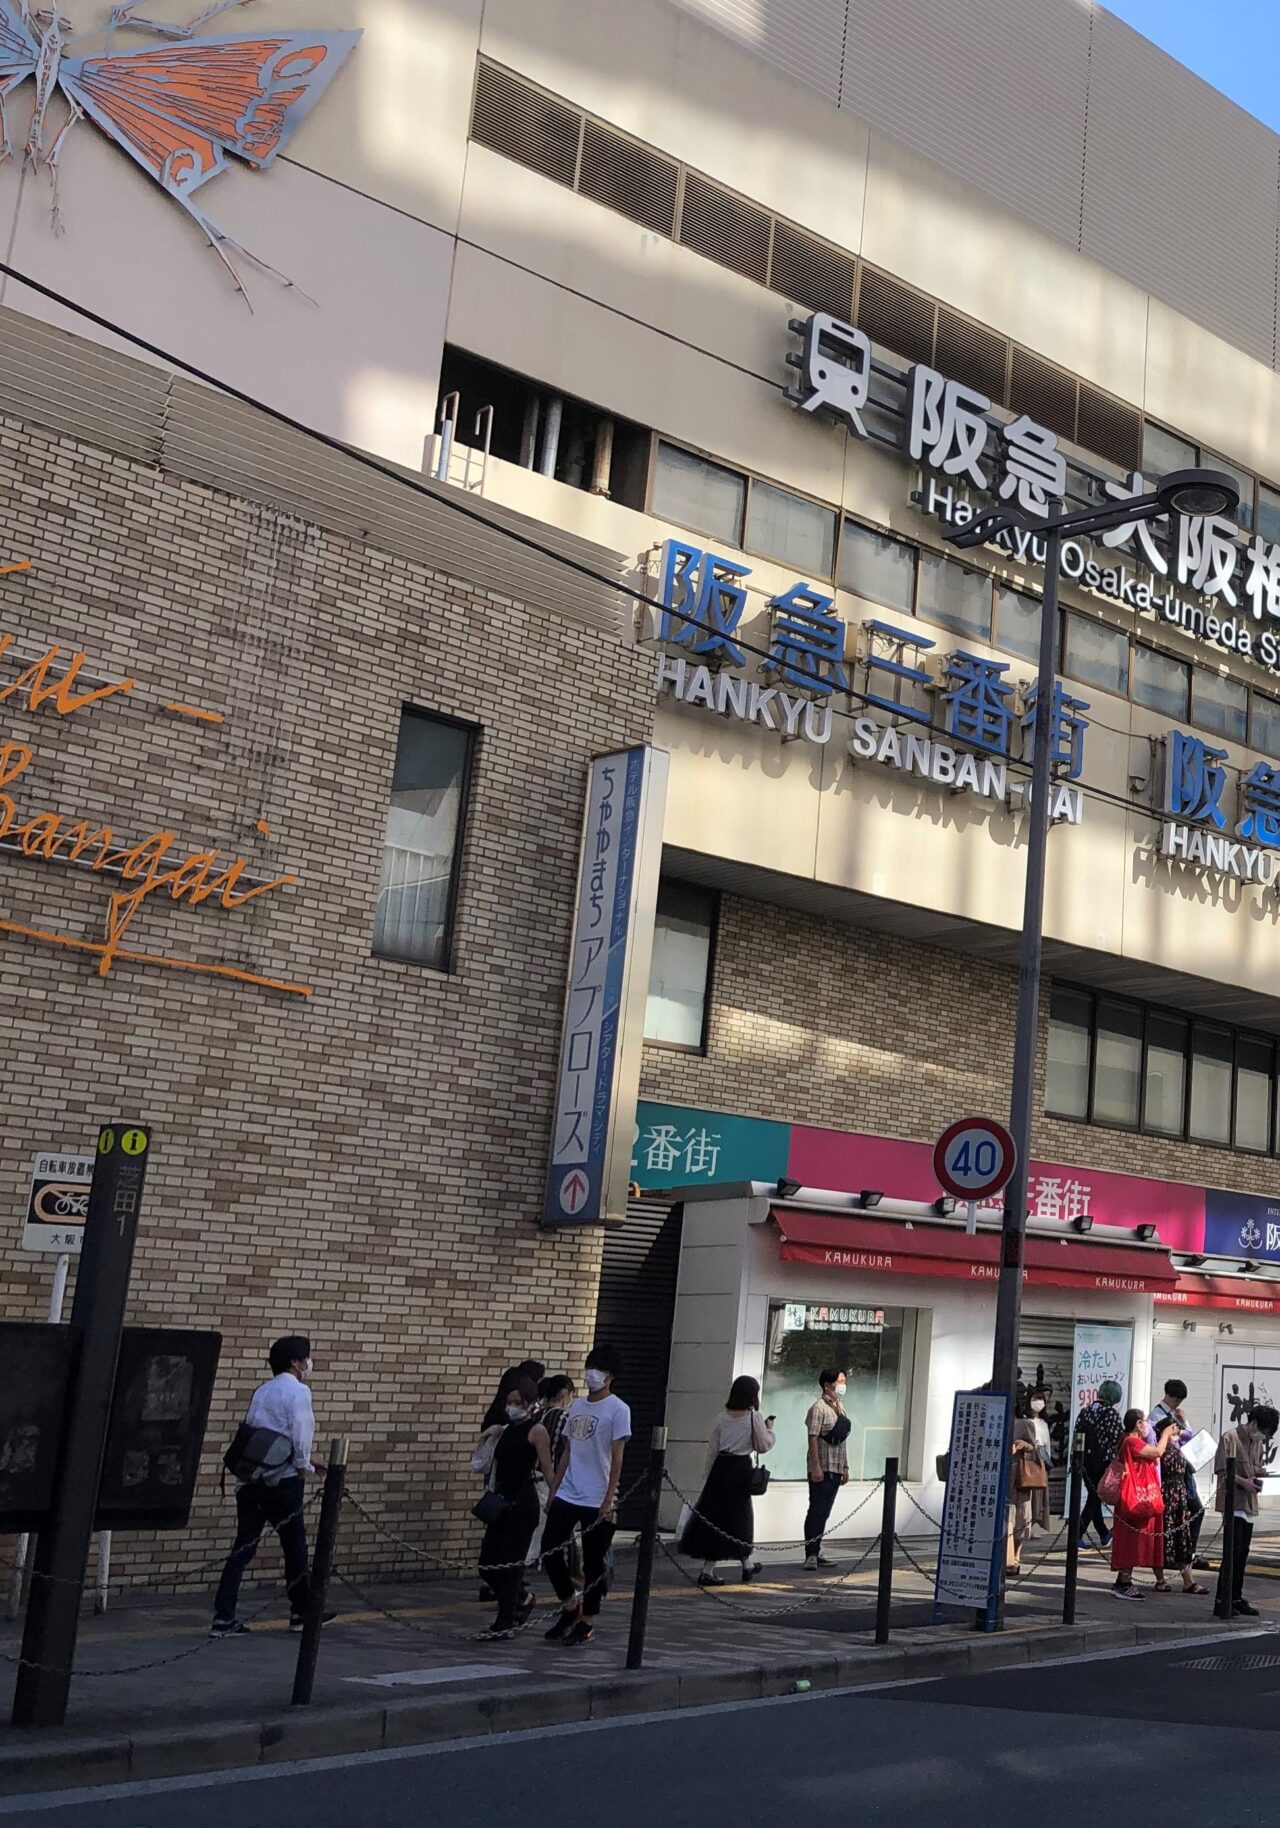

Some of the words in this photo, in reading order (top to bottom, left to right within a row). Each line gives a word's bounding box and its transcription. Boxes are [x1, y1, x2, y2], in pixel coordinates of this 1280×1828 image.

[906, 363, 1068, 520] 阪急
[927, 477, 1048, 563] Hayu
[1060, 541, 1253, 656] Osaka-umeda
[654, 538, 1091, 779] 阪急三番街
[656, 651, 833, 744] HANKYU
[852, 716, 1084, 826] SANBAN-AI
[1163, 821, 1277, 888] HANKYU
[951, 1140, 997, 1177] 40
[113, 1165, 141, 1237] 芝田1
[50, 1233, 85, 1246] 大阪
[824, 1250, 892, 1268] KAMUKURA
[970, 1264, 1028, 1280] KAMUA
[1095, 1276, 1145, 1290] KAMUKURA
[1153, 1292, 1188, 1303] MUKURA
[1235, 1297, 1274, 1310] KAMUKURA
[810, 1306, 885, 1324] KAMUKURA
[1078, 1348, 1118, 1371] 冷たい
[1076, 1370, 1126, 1386] おいしいラーメン
